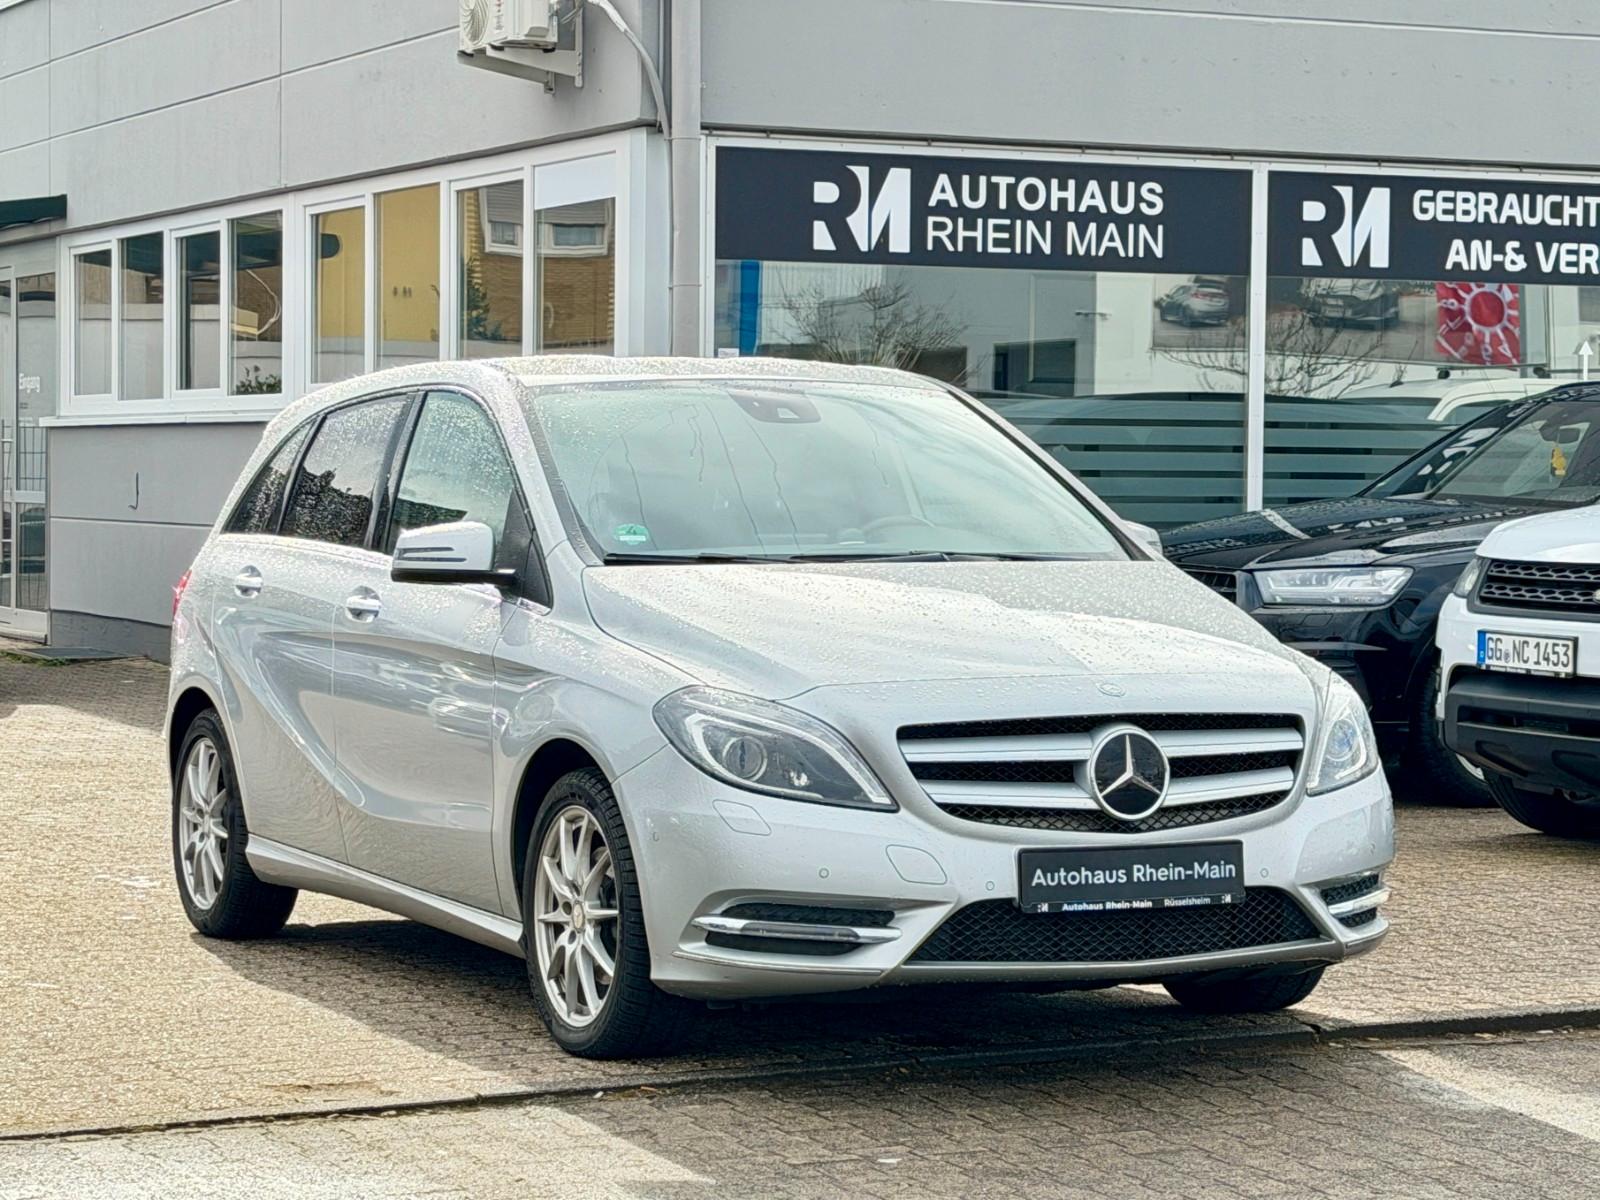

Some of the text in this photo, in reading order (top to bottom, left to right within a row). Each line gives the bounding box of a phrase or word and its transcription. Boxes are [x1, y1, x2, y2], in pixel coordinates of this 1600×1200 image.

[928, 174, 1164, 216] AUTOHAUS
[1412, 189, 1600, 227] GEBRAUCHT
[927, 216, 1164, 258] RHEIN MAIN
[1536, 242, 1600, 274] VER
[1487, 637, 1570, 667] GG NC 1453
[1031, 861, 1236, 887] Autohaus Rhein-Main
[1062, 902, 1104, 912] Autohaus
[1105, 899, 1153, 910] Rhein-Main
[1164, 897, 1211, 907] Rüsselsheim
